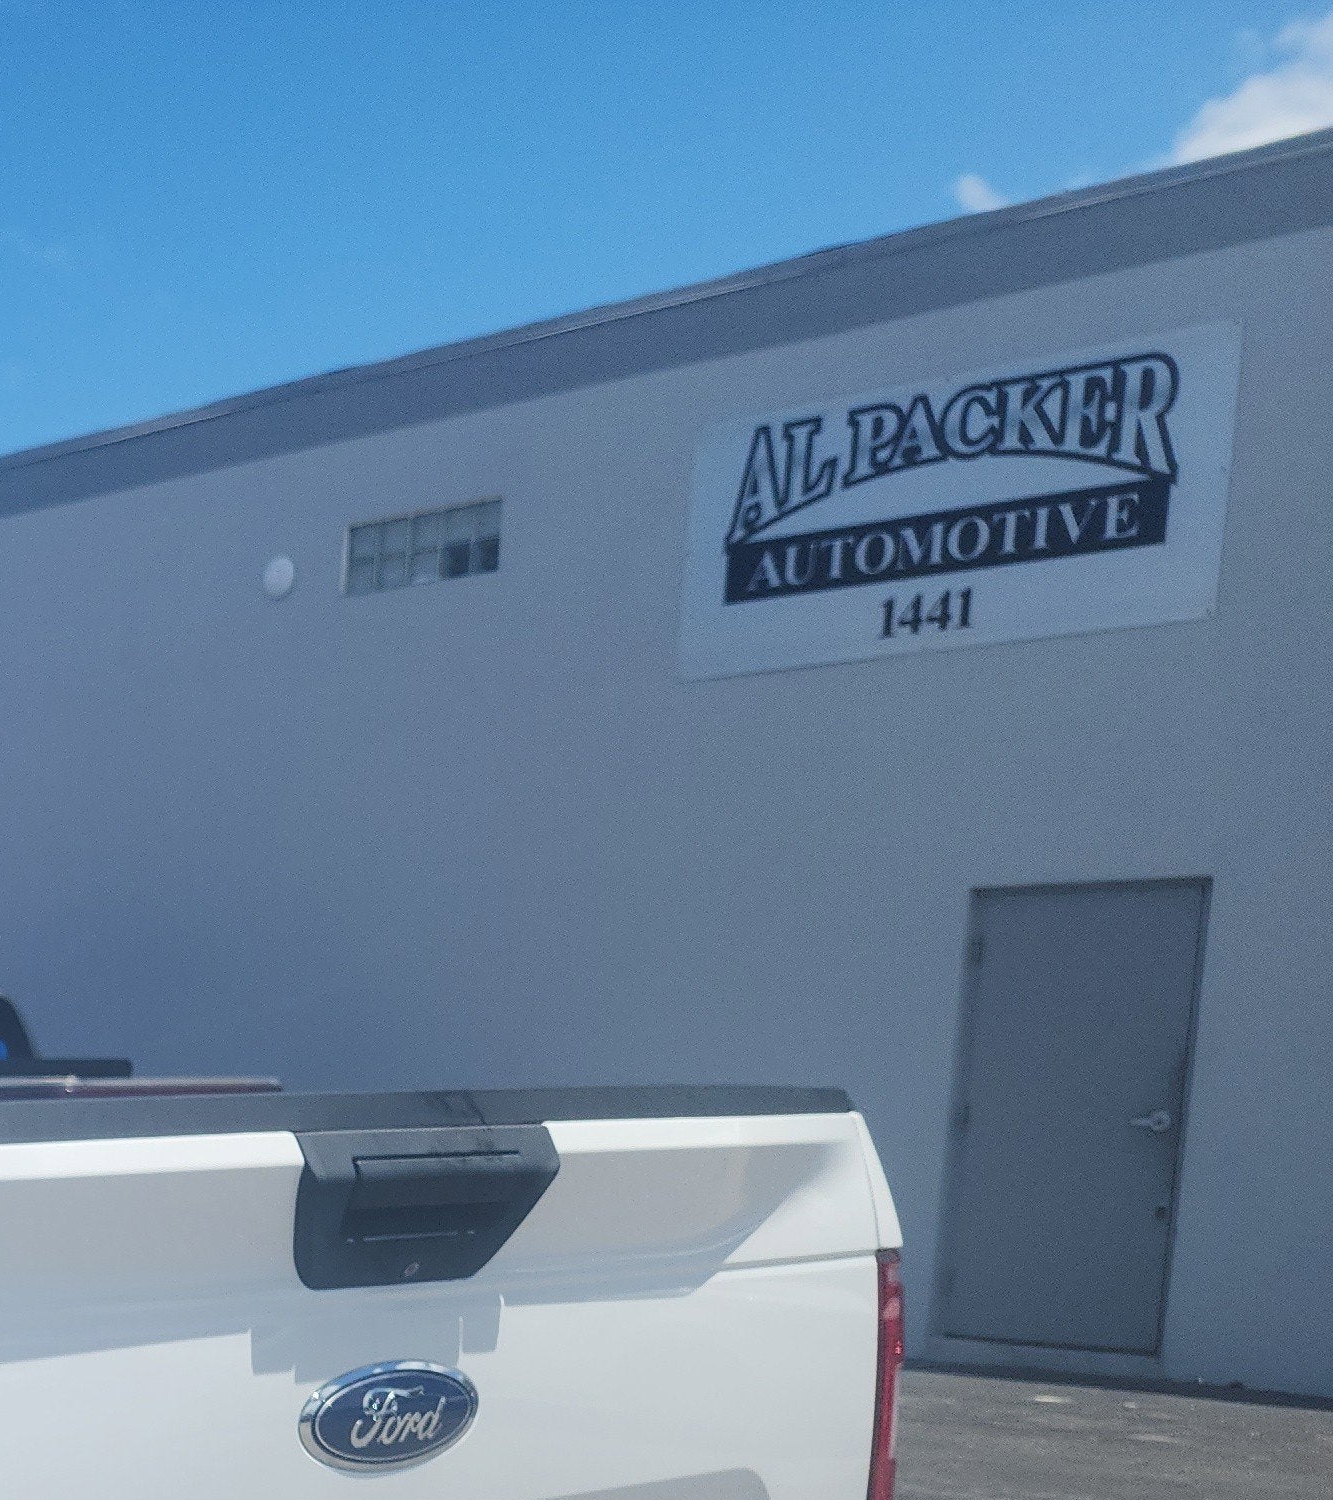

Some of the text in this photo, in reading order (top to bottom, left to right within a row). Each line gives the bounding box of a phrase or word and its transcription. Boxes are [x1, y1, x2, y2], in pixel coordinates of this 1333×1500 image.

[726, 352, 1179, 546] AL PACKER
[744, 490, 1141, 594] AUTOMOTIVE
[878, 587, 975, 641] 1441
[349, 1384, 447, 1449] Ford
